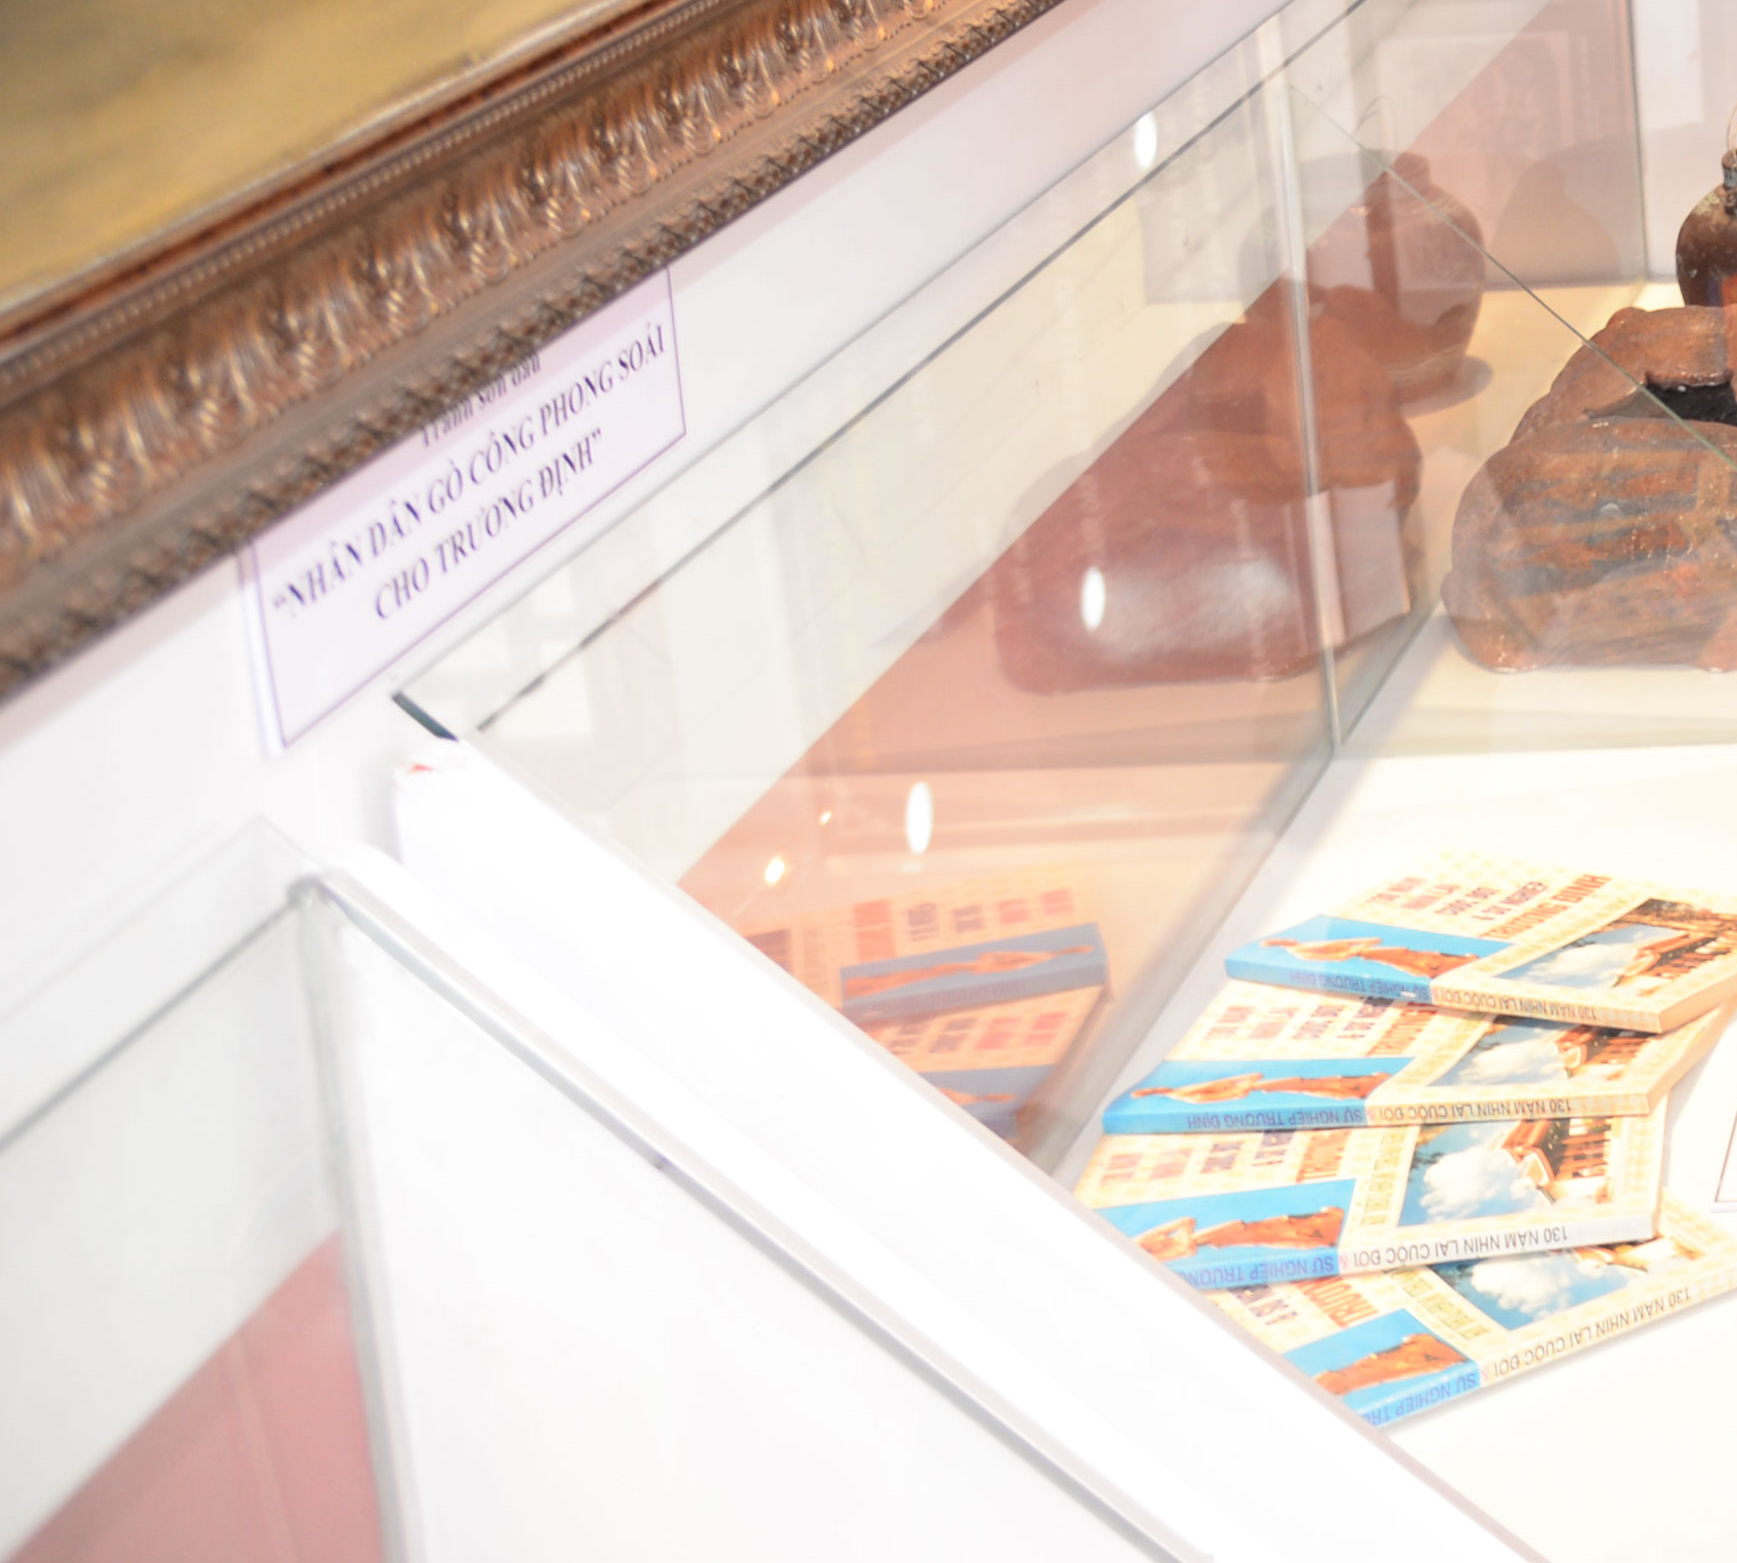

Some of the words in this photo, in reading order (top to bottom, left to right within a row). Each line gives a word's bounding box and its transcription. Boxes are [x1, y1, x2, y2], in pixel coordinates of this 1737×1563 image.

[368, 499, 422, 558] DÂN
[428, 458, 463, 515] GÒ
[470, 416, 535, 485] CÔNG
[540, 360, 614, 436] PHONG
[618, 321, 665, 381] SOÁI
[376, 557, 430, 619] CHO
[1288, 1108, 1339, 1127] NGHIỆP
[1407, 1103, 1448, 1123] CUỘC
[1549, 1098, 1572, 1115] 130
[1186, 1111, 1220, 1130] ĐỊNH
[1464, 1233, 1501, 1255] NHÌN
[1503, 1228, 1540, 1251] NĂM
[1544, 1225, 1569, 1243] 130
[1353, 1248, 1382, 1270] ĐỜI
[1385, 1241, 1431, 1266] CUỘC
[1435, 1237, 1460, 1259] LẠI
[1250, 1258, 1309, 1282] NGHIỆP
[1312, 1251, 1335, 1276] SỰ
[1668, 1286, 1692, 1309] 130
[1595, 1305, 1630, 1337] NHÌN
[1569, 1321, 1592, 1348] LẠI
[1522, 1334, 1566, 1366] CUỘC
[1493, 1351, 1520, 1377] ĐỜI
[1455, 1369, 1477, 1393] SỰ
[1394, 1378, 1451, 1412] NGHIỆP
